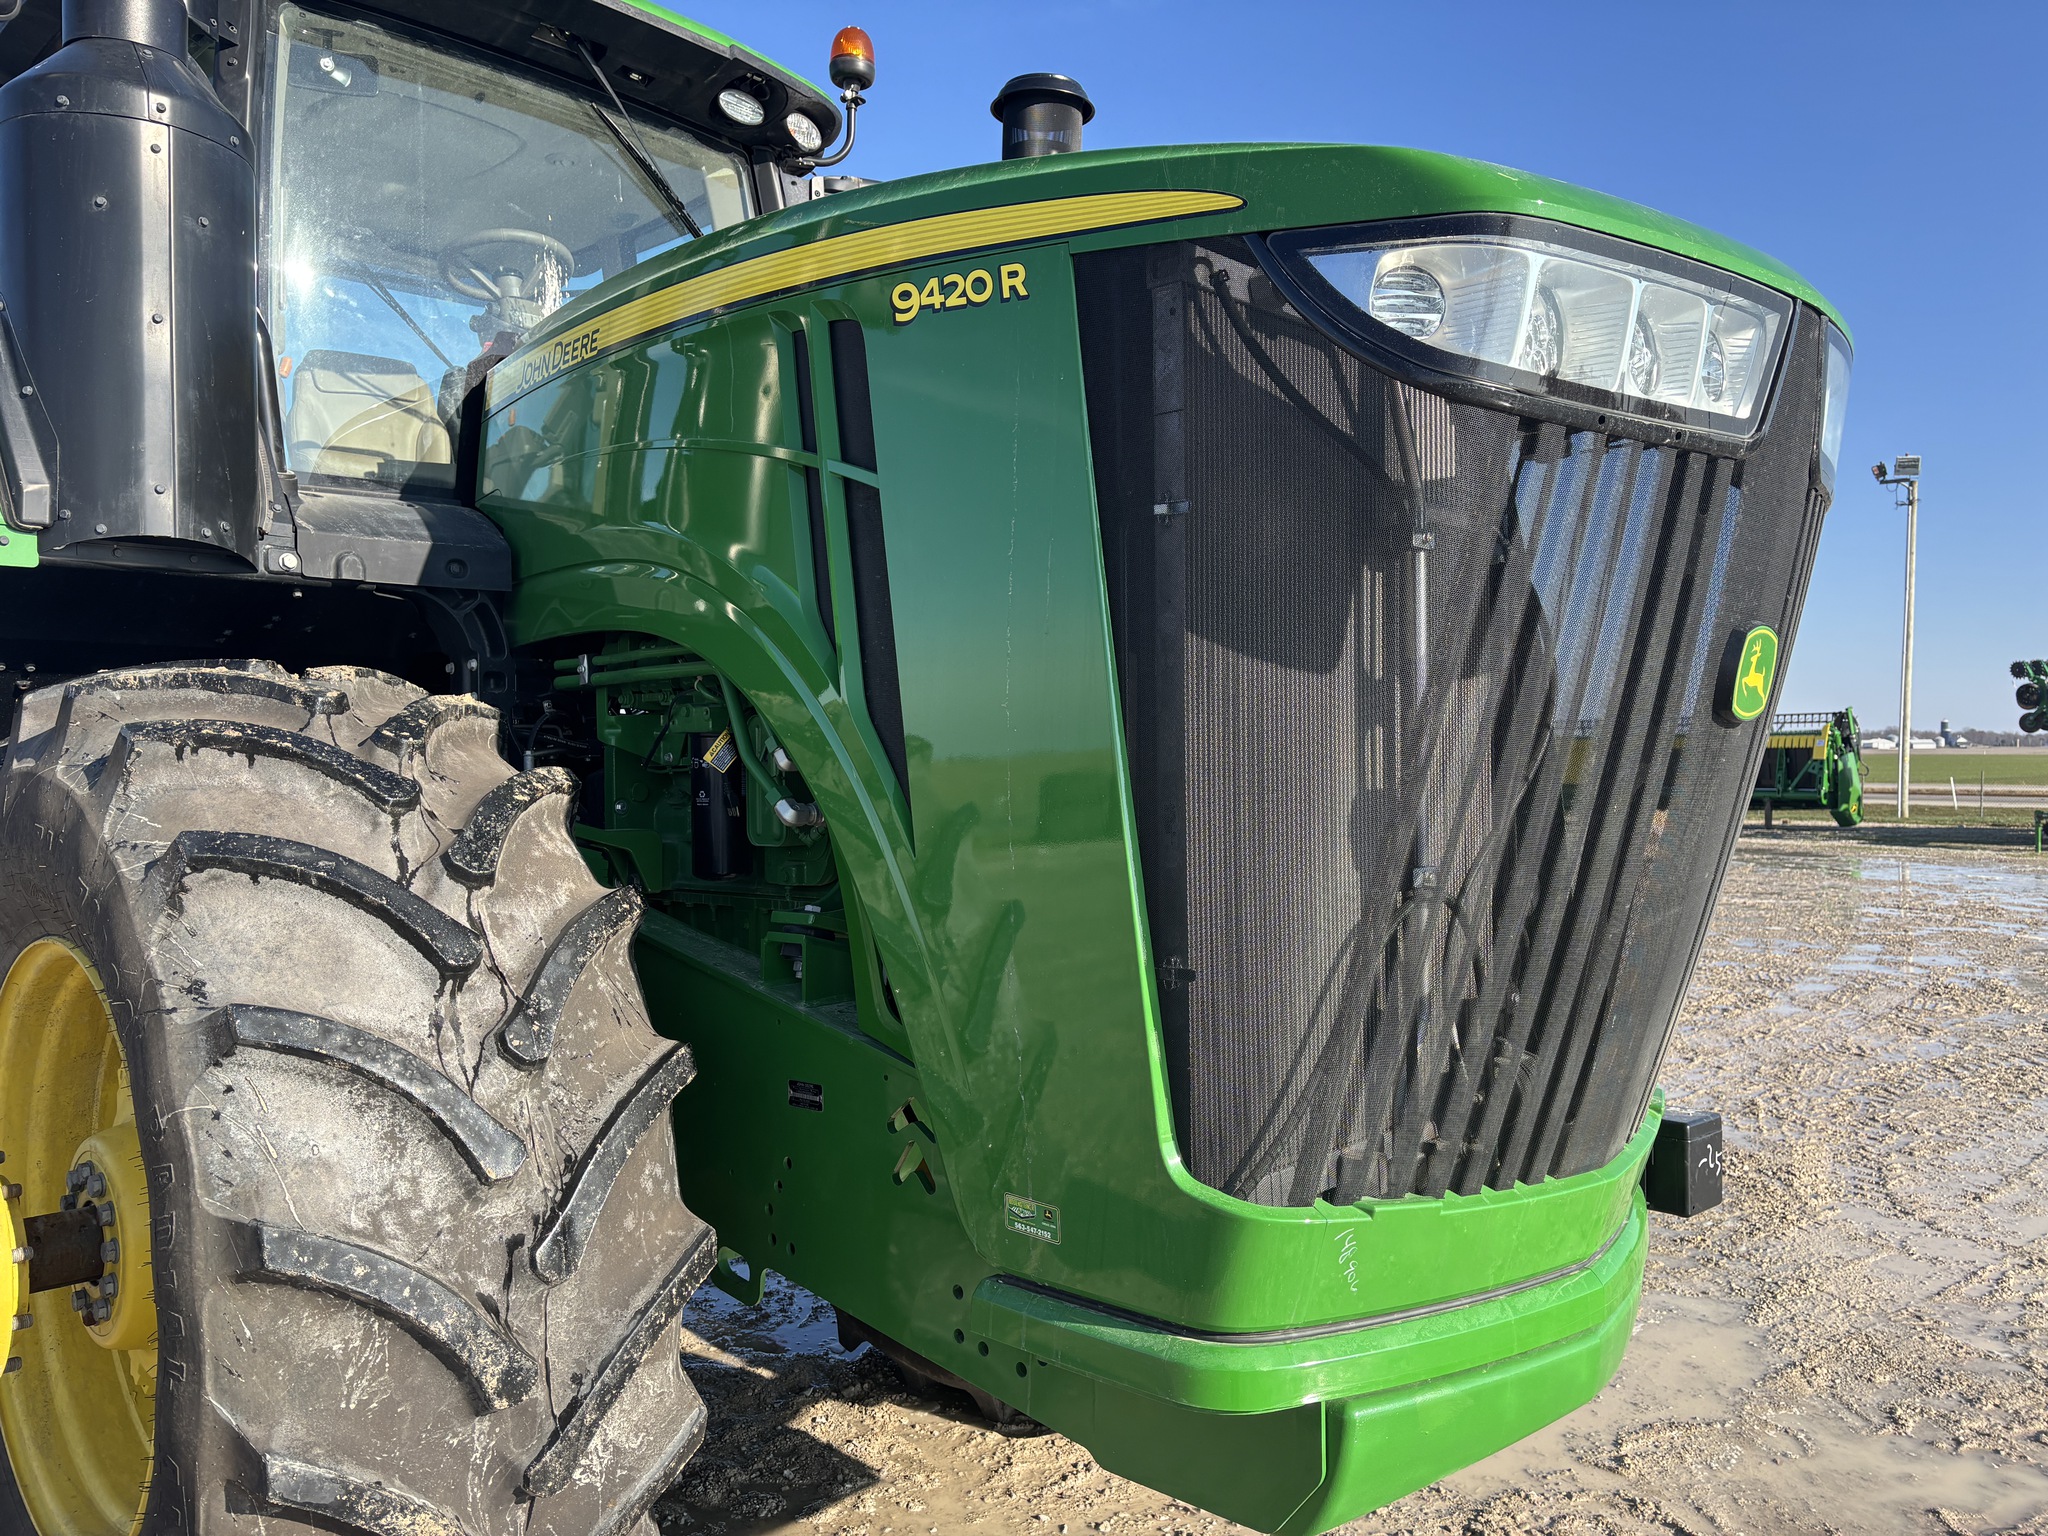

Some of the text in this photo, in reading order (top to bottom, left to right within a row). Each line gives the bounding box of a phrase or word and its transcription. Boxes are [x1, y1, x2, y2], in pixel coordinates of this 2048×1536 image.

[890, 262, 1030, 325] 9420 R
[515, 328, 600, 393] JOHN DEERE
